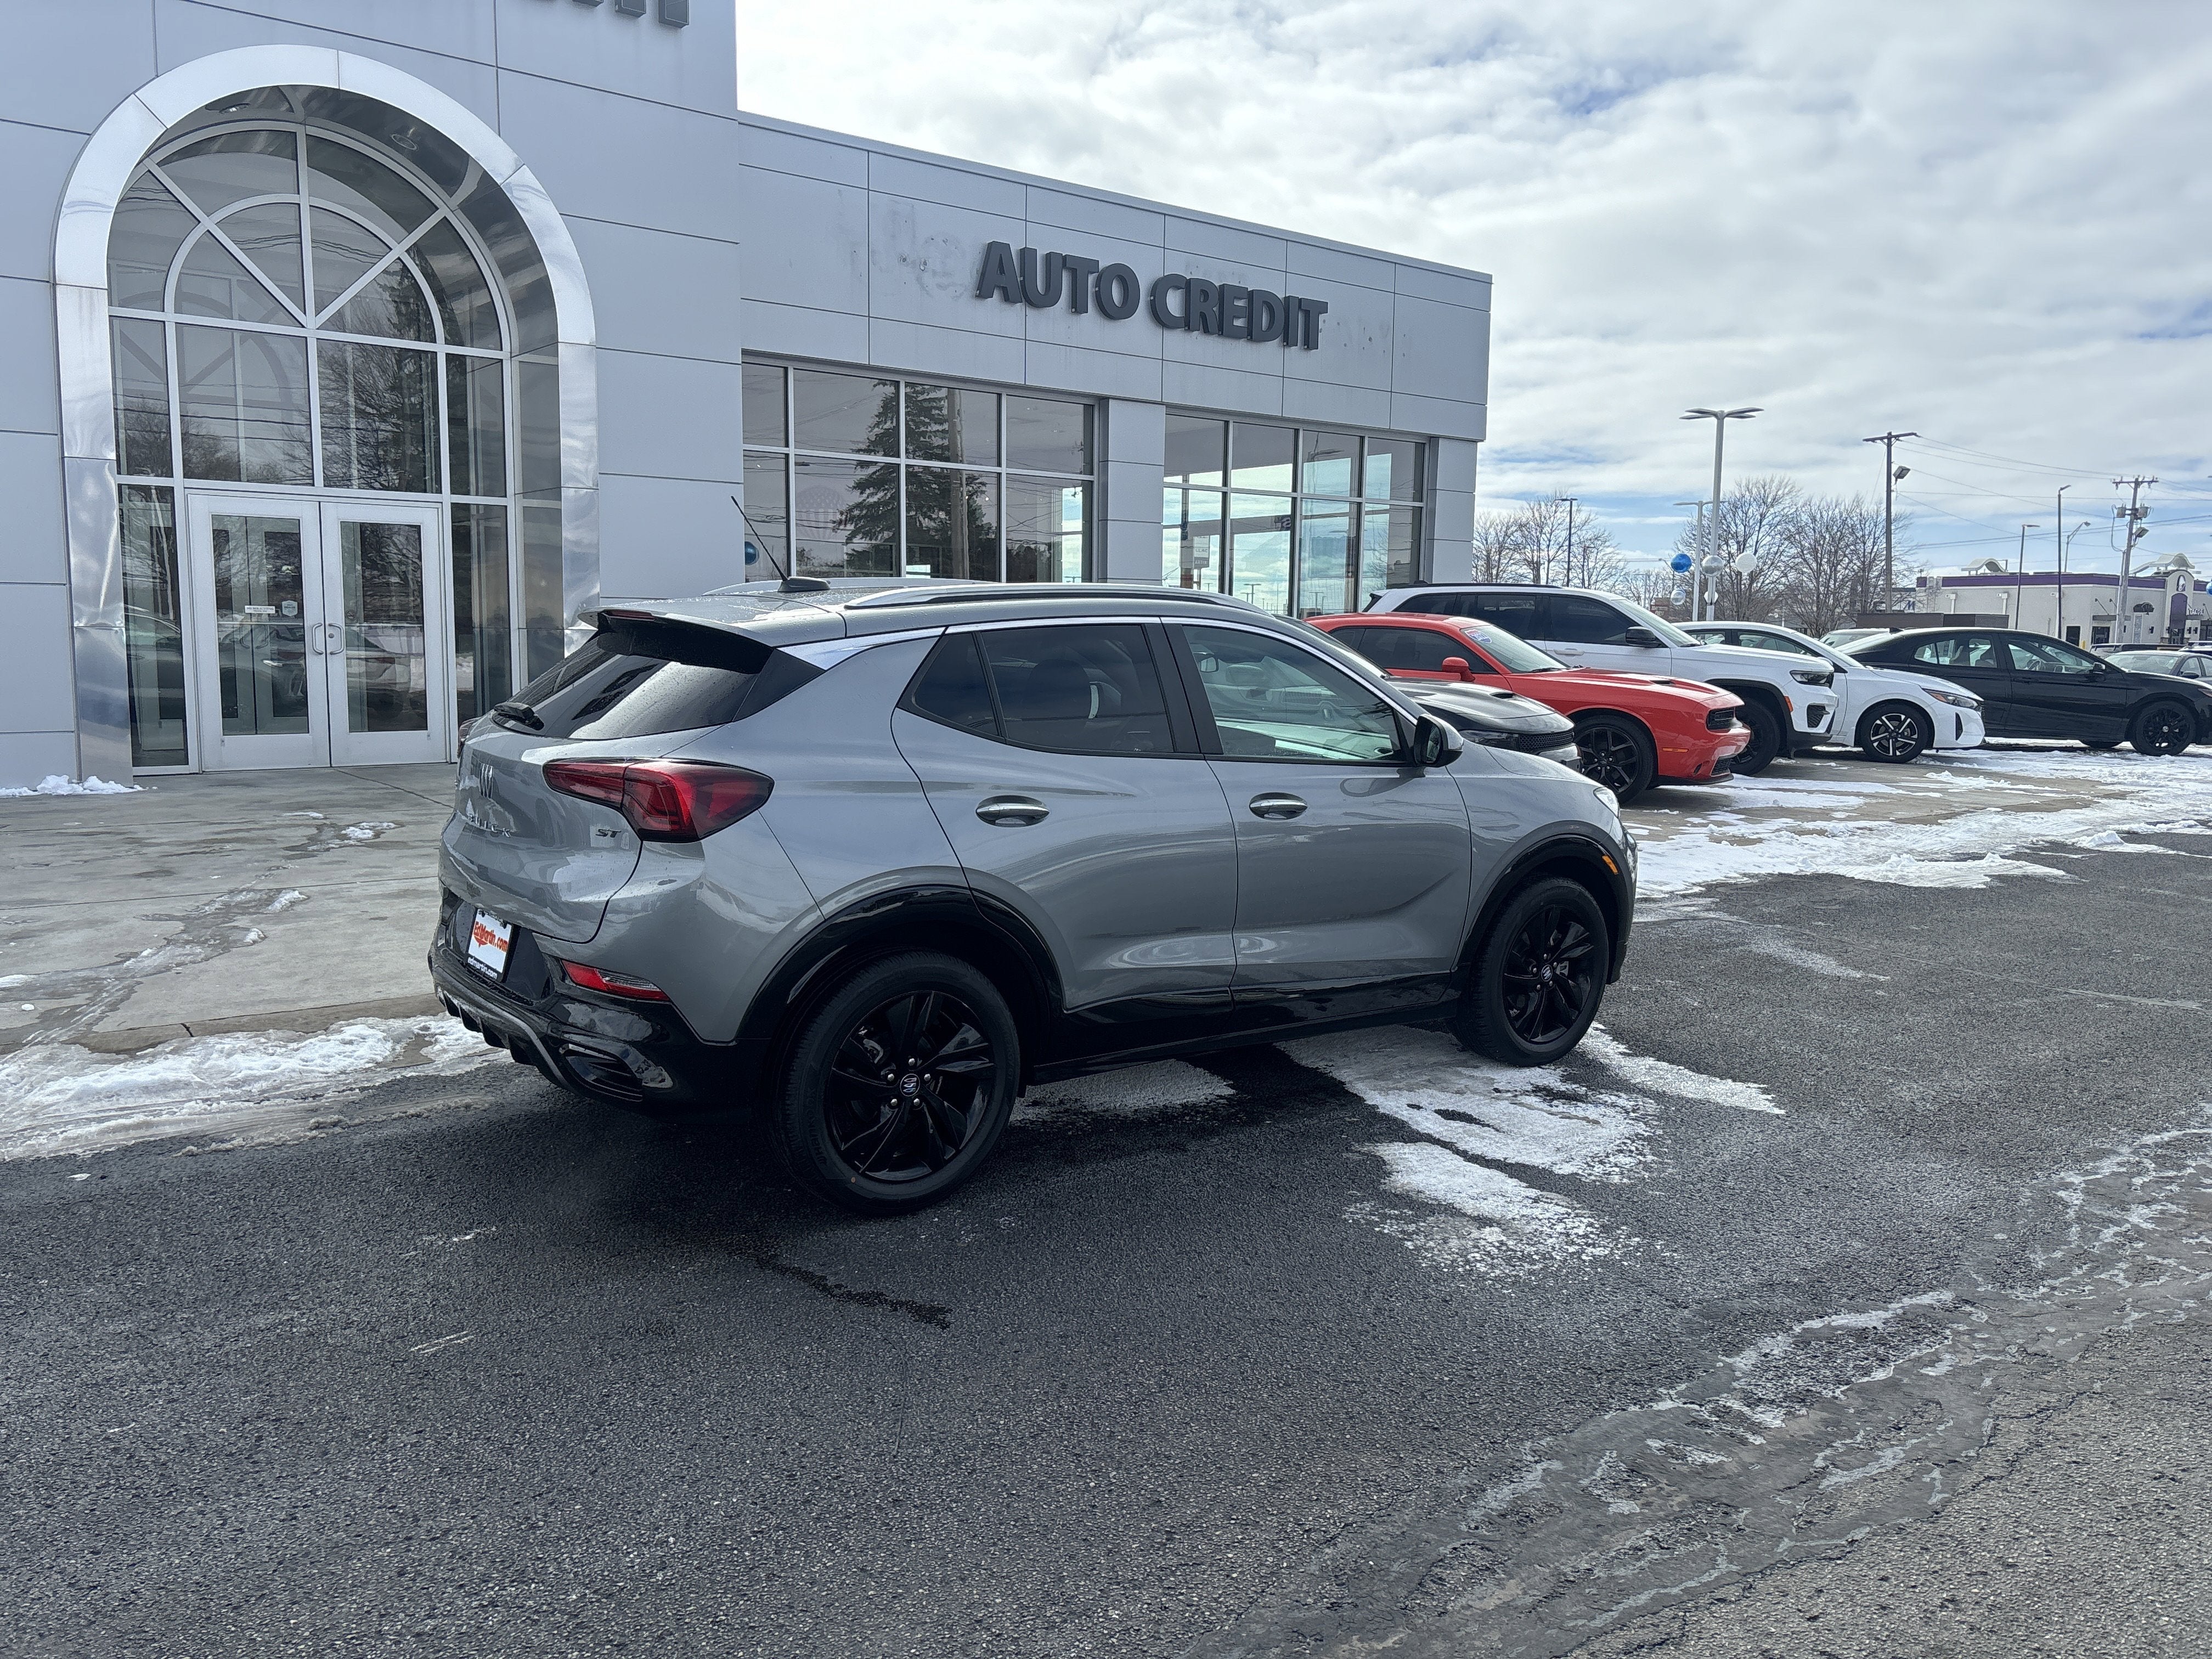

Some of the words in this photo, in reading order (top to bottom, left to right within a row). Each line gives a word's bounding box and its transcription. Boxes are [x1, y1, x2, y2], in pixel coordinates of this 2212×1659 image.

[975, 240, 1141, 321] AUTO
[1150, 273, 1328, 351] CREDIT
[596, 828, 622, 838] ST
[473, 921, 509, 952] EdMartin.com
[468, 957, 497, 980] edmartin.com
